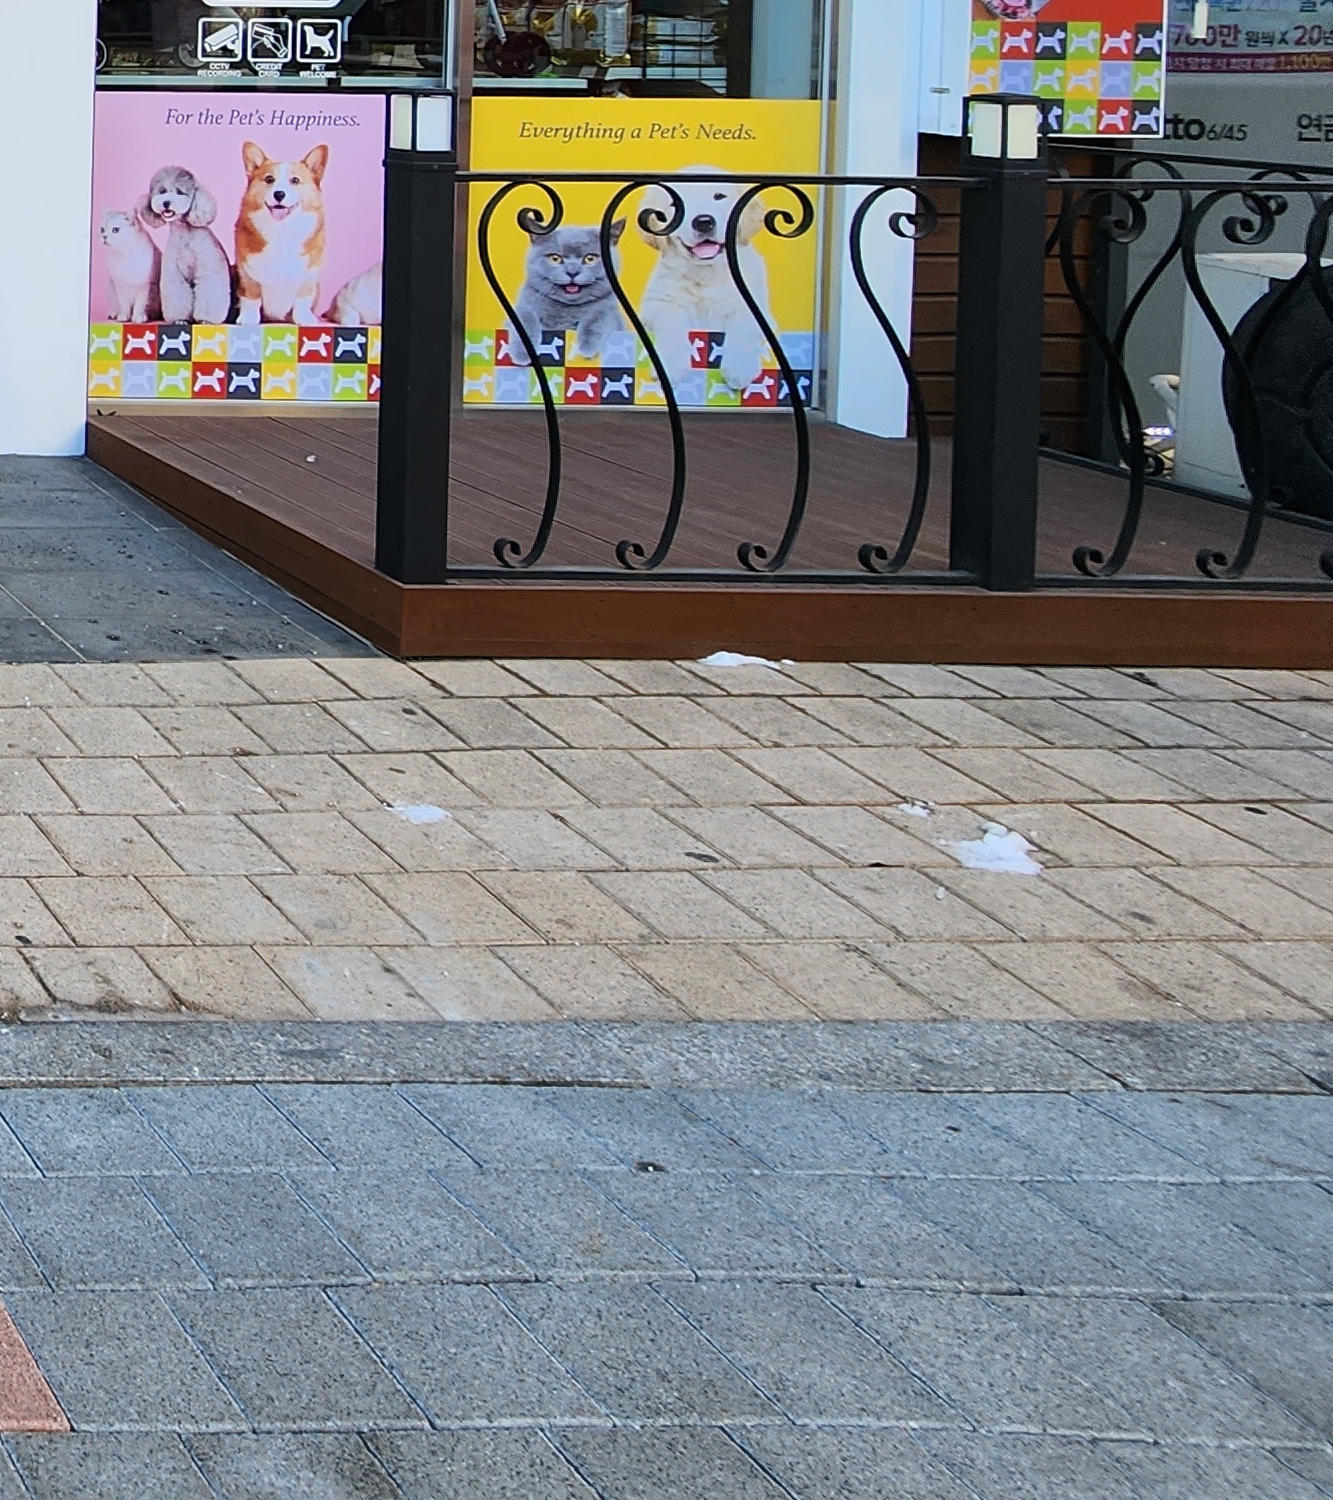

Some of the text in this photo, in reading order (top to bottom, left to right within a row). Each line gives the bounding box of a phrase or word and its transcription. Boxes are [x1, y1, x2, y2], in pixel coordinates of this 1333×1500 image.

[164, 107, 362, 132] For the Pet's Happiness.
[519, 120, 758, 146] Everything a Pet's Needs.
